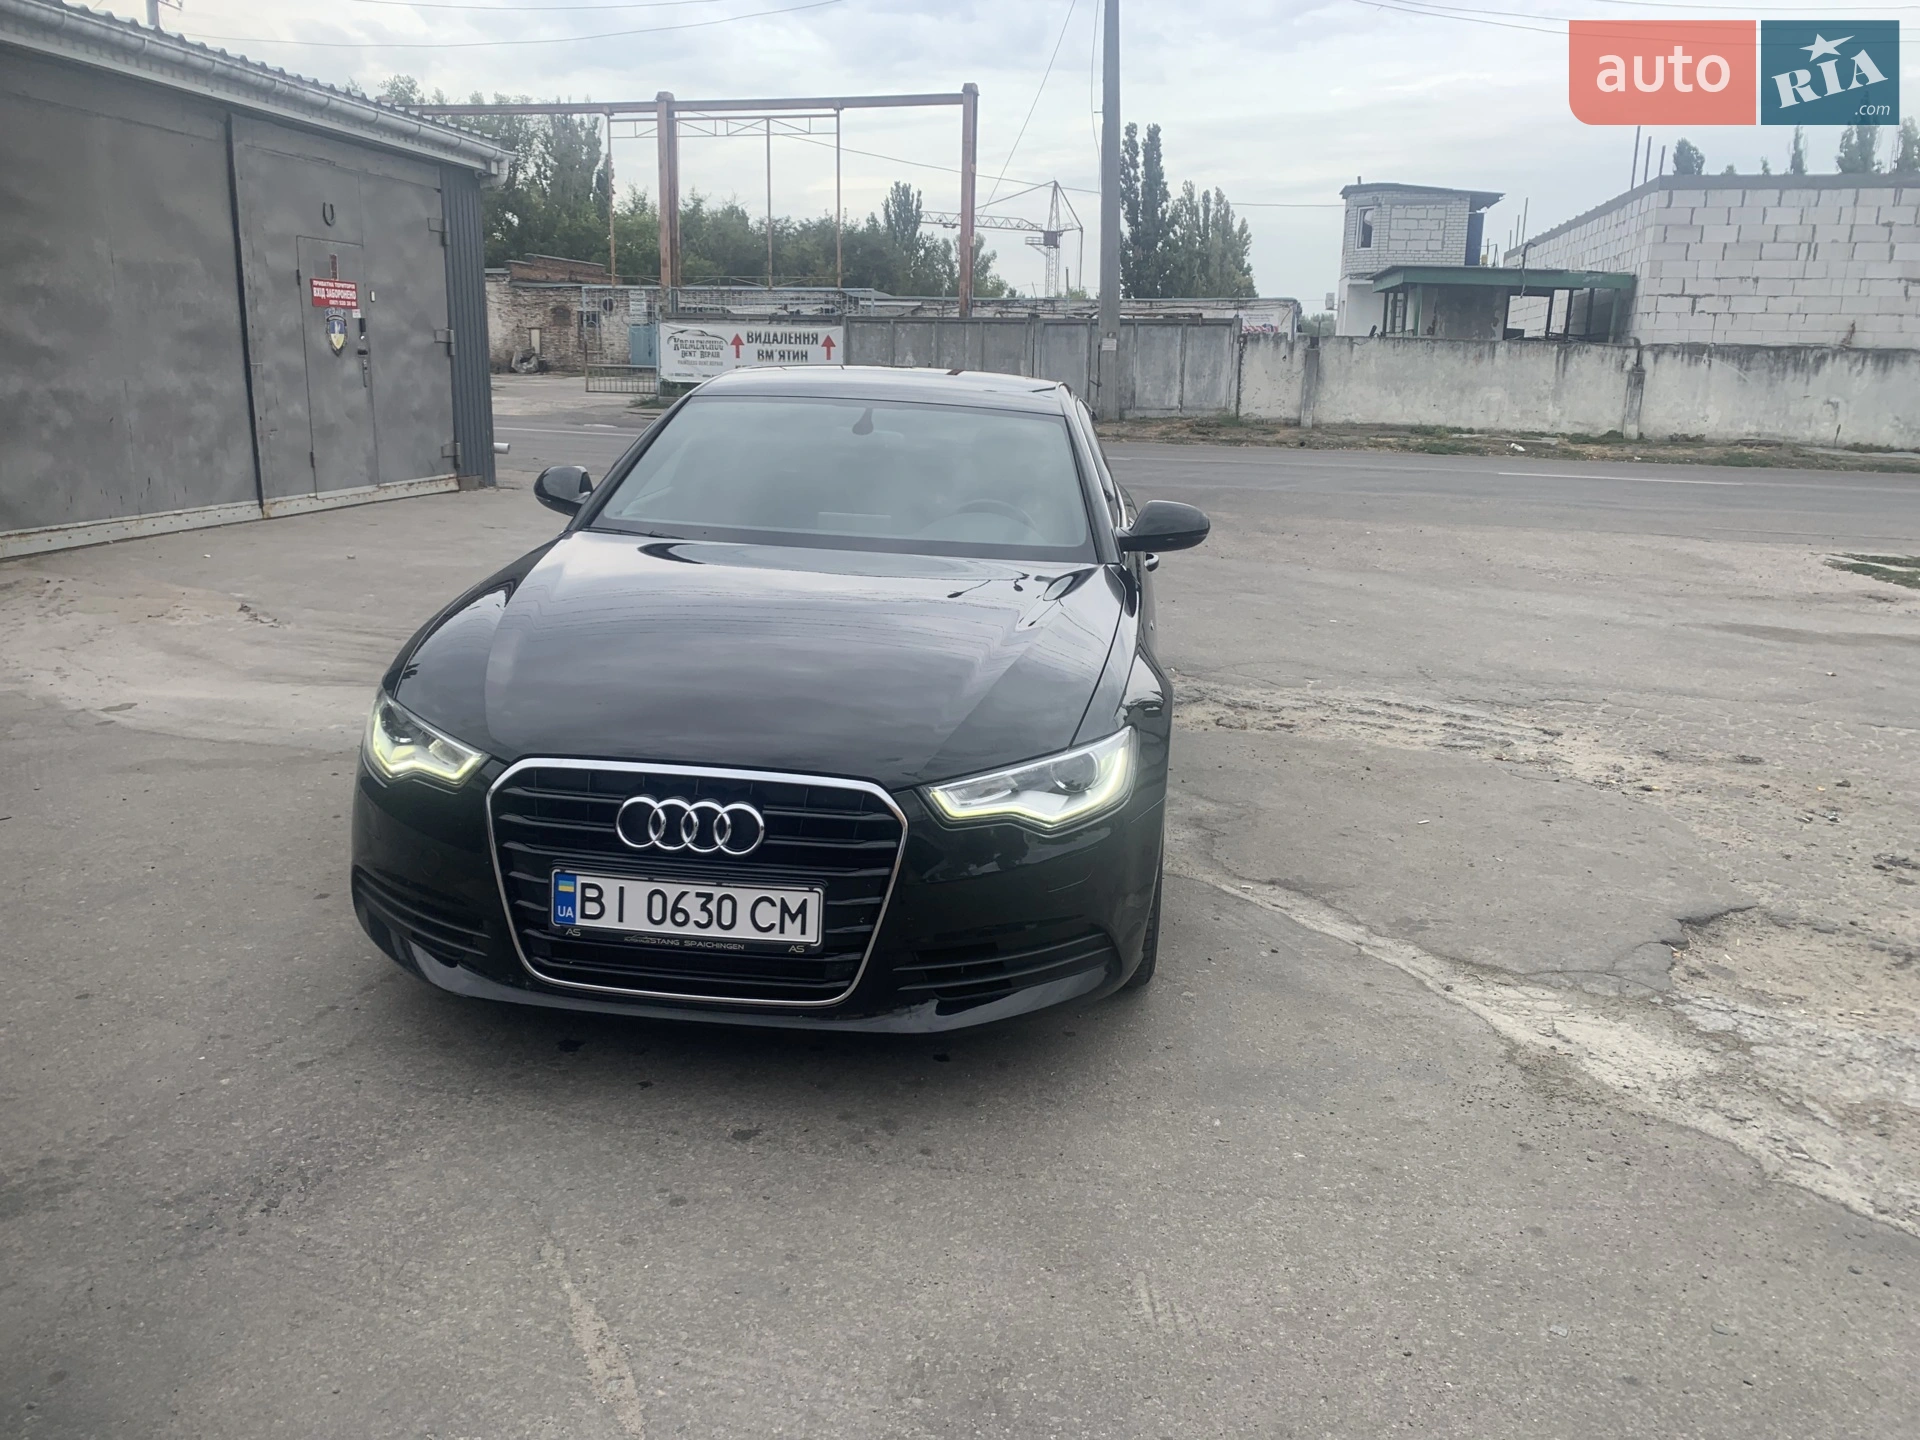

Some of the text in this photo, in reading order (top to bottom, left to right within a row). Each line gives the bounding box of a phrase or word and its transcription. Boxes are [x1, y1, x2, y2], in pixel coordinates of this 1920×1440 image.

[313, 287, 357, 300] ВХІД ЗАБОРОНЕНО
[674, 338, 724, 350] KREMENCHUG
[747, 331, 819, 346] ВИДАЛЕННЯ
[558, 905, 574, 918] UA
[647, 888, 738, 931] 0630
[750, 895, 808, 936] CM
[565, 928, 581, 937] AS
[684, 940, 745, 950] SPAICHINGEN
[788, 945, 805, 953] AS
